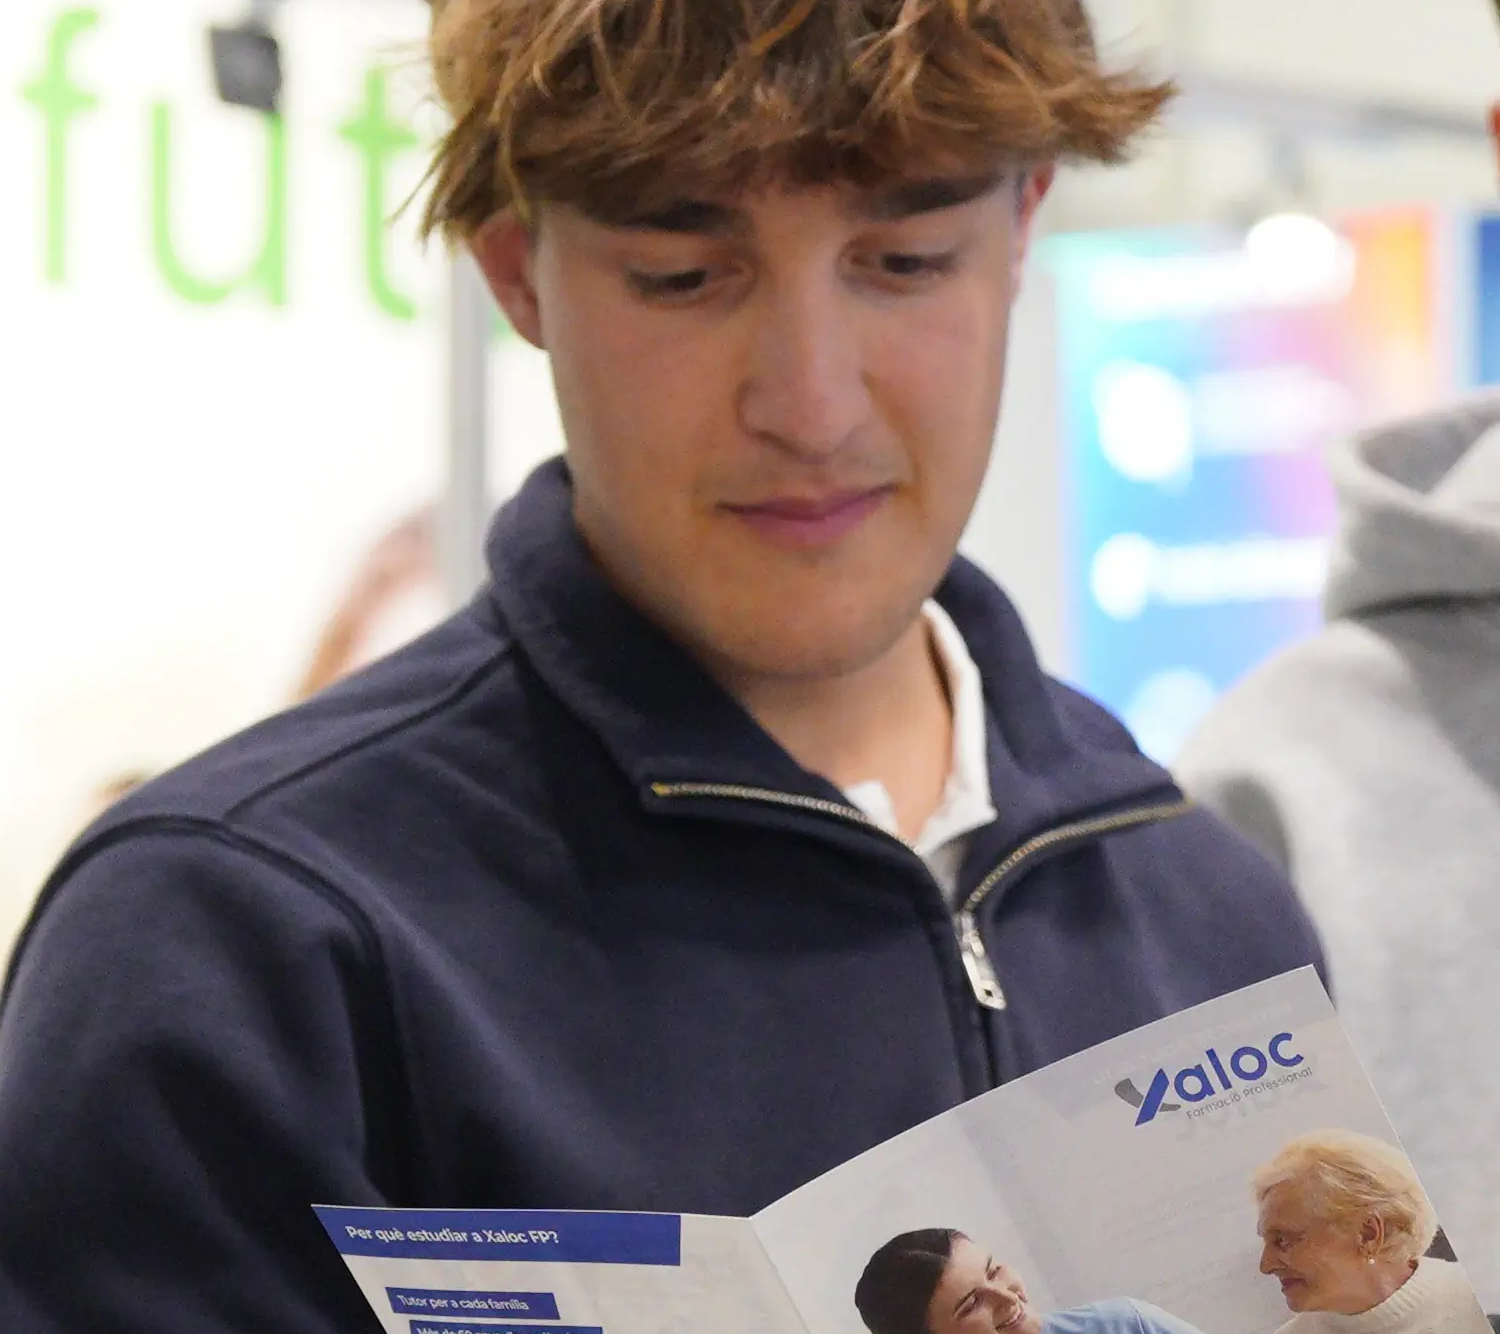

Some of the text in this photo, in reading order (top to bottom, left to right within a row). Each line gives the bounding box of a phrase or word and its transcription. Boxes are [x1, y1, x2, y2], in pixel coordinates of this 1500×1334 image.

[1114, 1032, 1305, 1127] Xaloc
[345, 1226, 559, 1244] Per què estudiar a Xaloc FP?
[397, 1295, 428, 1307] Tutor
[430, 1298, 448, 1309] per
[451, 1300, 459, 1308] a
[461, 1299, 488, 1309] cada
